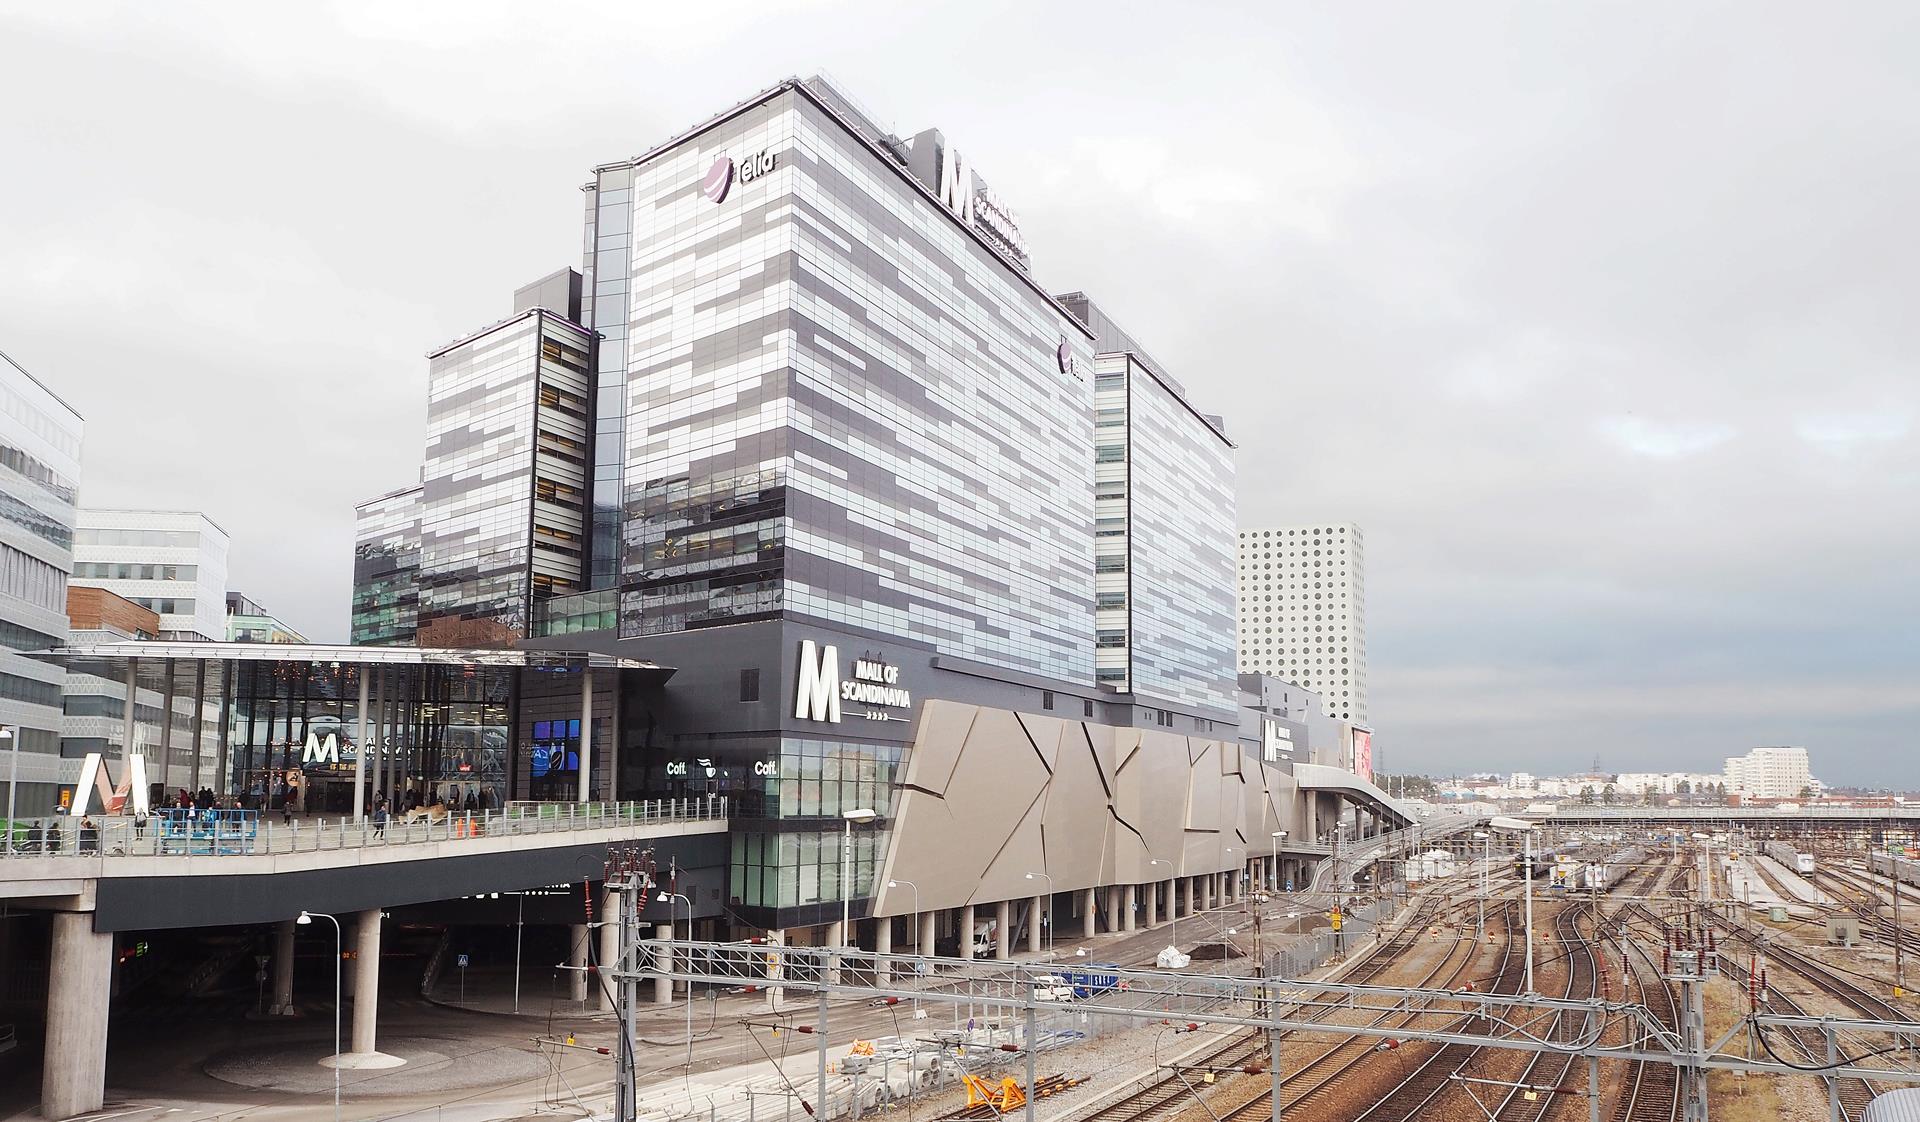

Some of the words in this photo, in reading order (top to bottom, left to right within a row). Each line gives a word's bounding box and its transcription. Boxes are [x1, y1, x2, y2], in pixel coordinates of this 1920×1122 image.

[733, 150, 775, 184] Telia
[940, 134, 975, 228] M
[795, 639, 841, 724] M
[855, 659, 884, 682] MALL
[884, 665, 899, 685] OF
[841, 680, 911, 709] SCANDINAVIA
[302, 732, 339, 763] M
[667, 762, 687, 775] Coff.
[754, 760, 777, 776] Coff.
